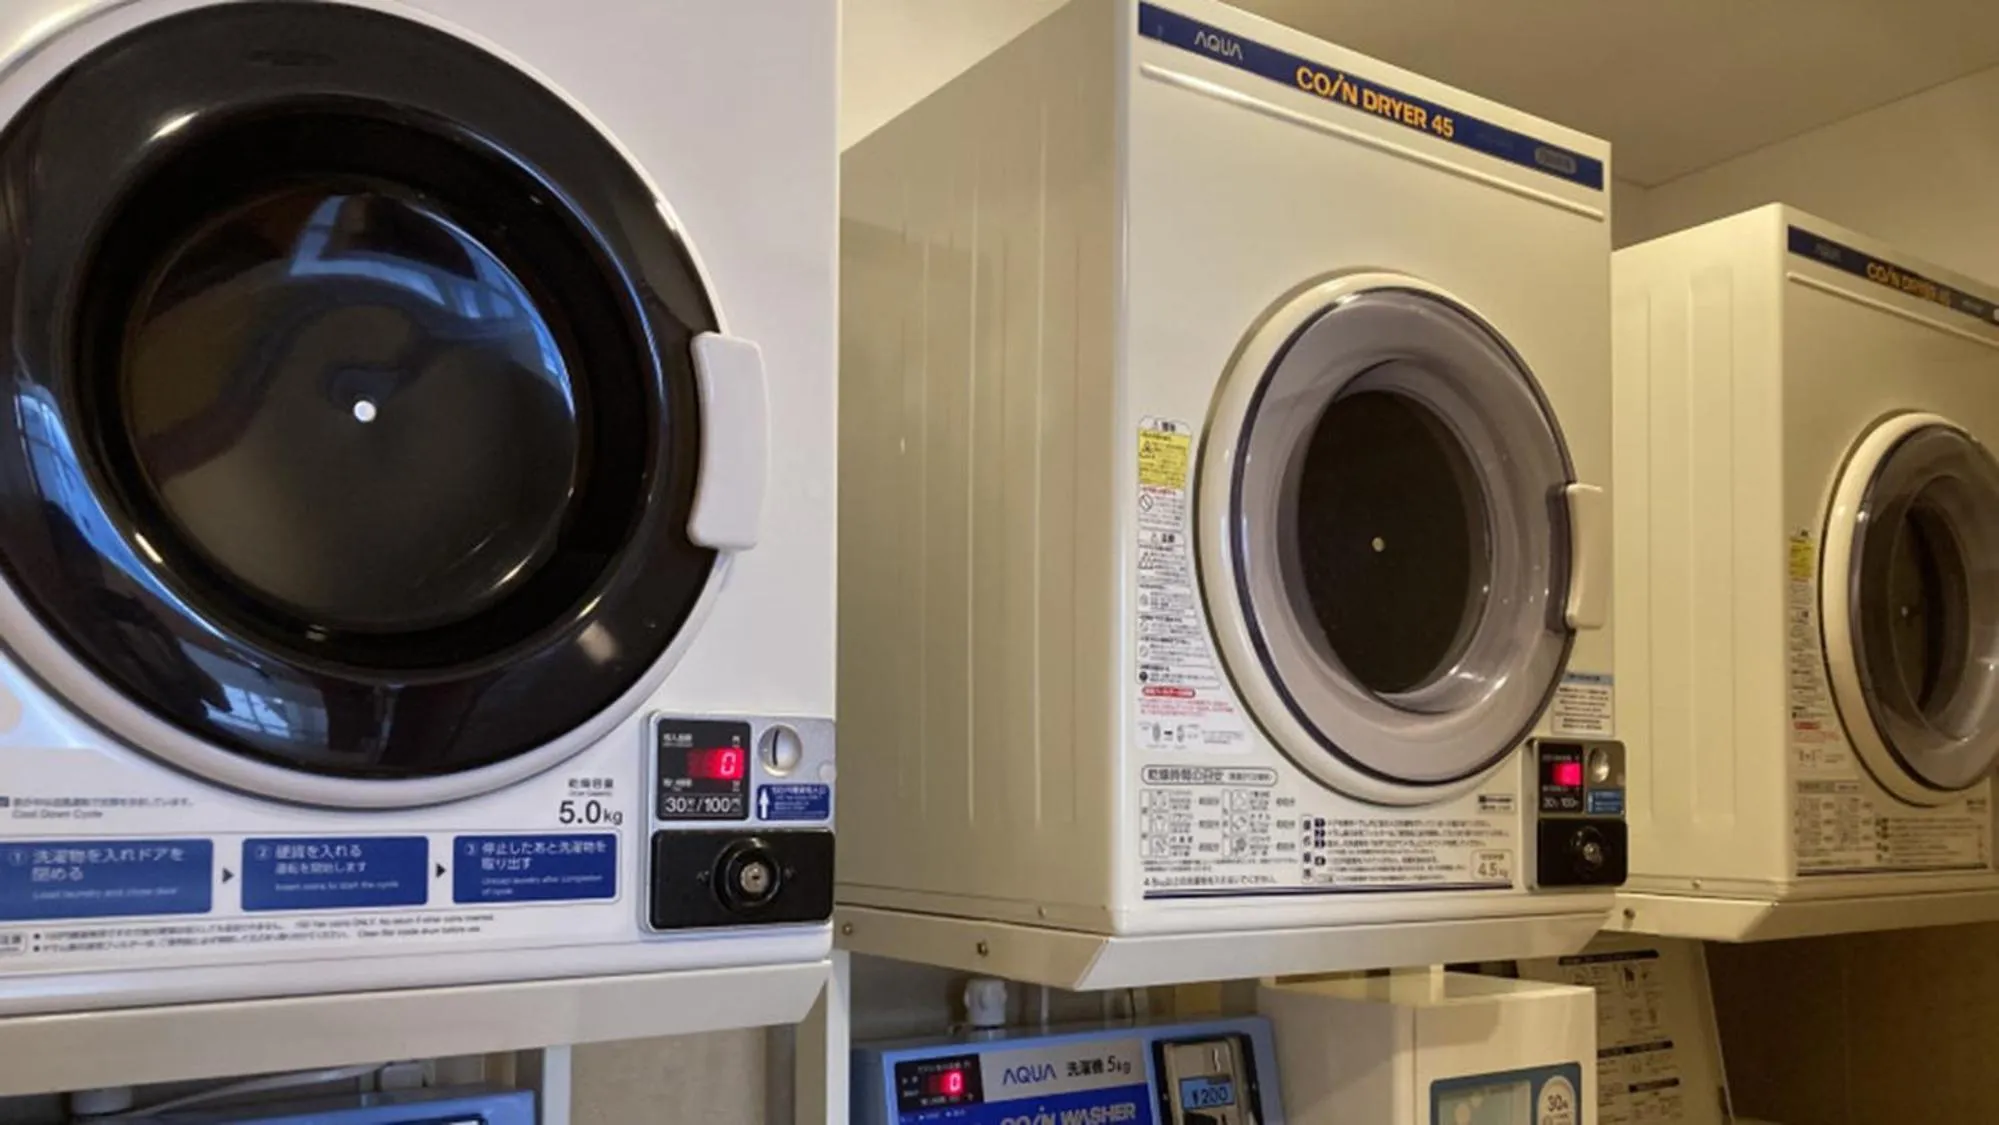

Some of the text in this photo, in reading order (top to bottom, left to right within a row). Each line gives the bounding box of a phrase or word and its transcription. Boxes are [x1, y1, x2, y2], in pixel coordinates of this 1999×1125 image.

[1193, 30, 1243, 61] AQUA
[1295, 65, 1455, 138] COIN DRYER 45
[720, 752, 737, 776] 0
[41, 808, 71, 819] Down
[73, 808, 103, 820] Cycle
[482, 857, 533, 871] 取り出す
[1002, 1063, 1058, 1086] AQUA
[1060, 1102, 1136, 1124] WASHER
